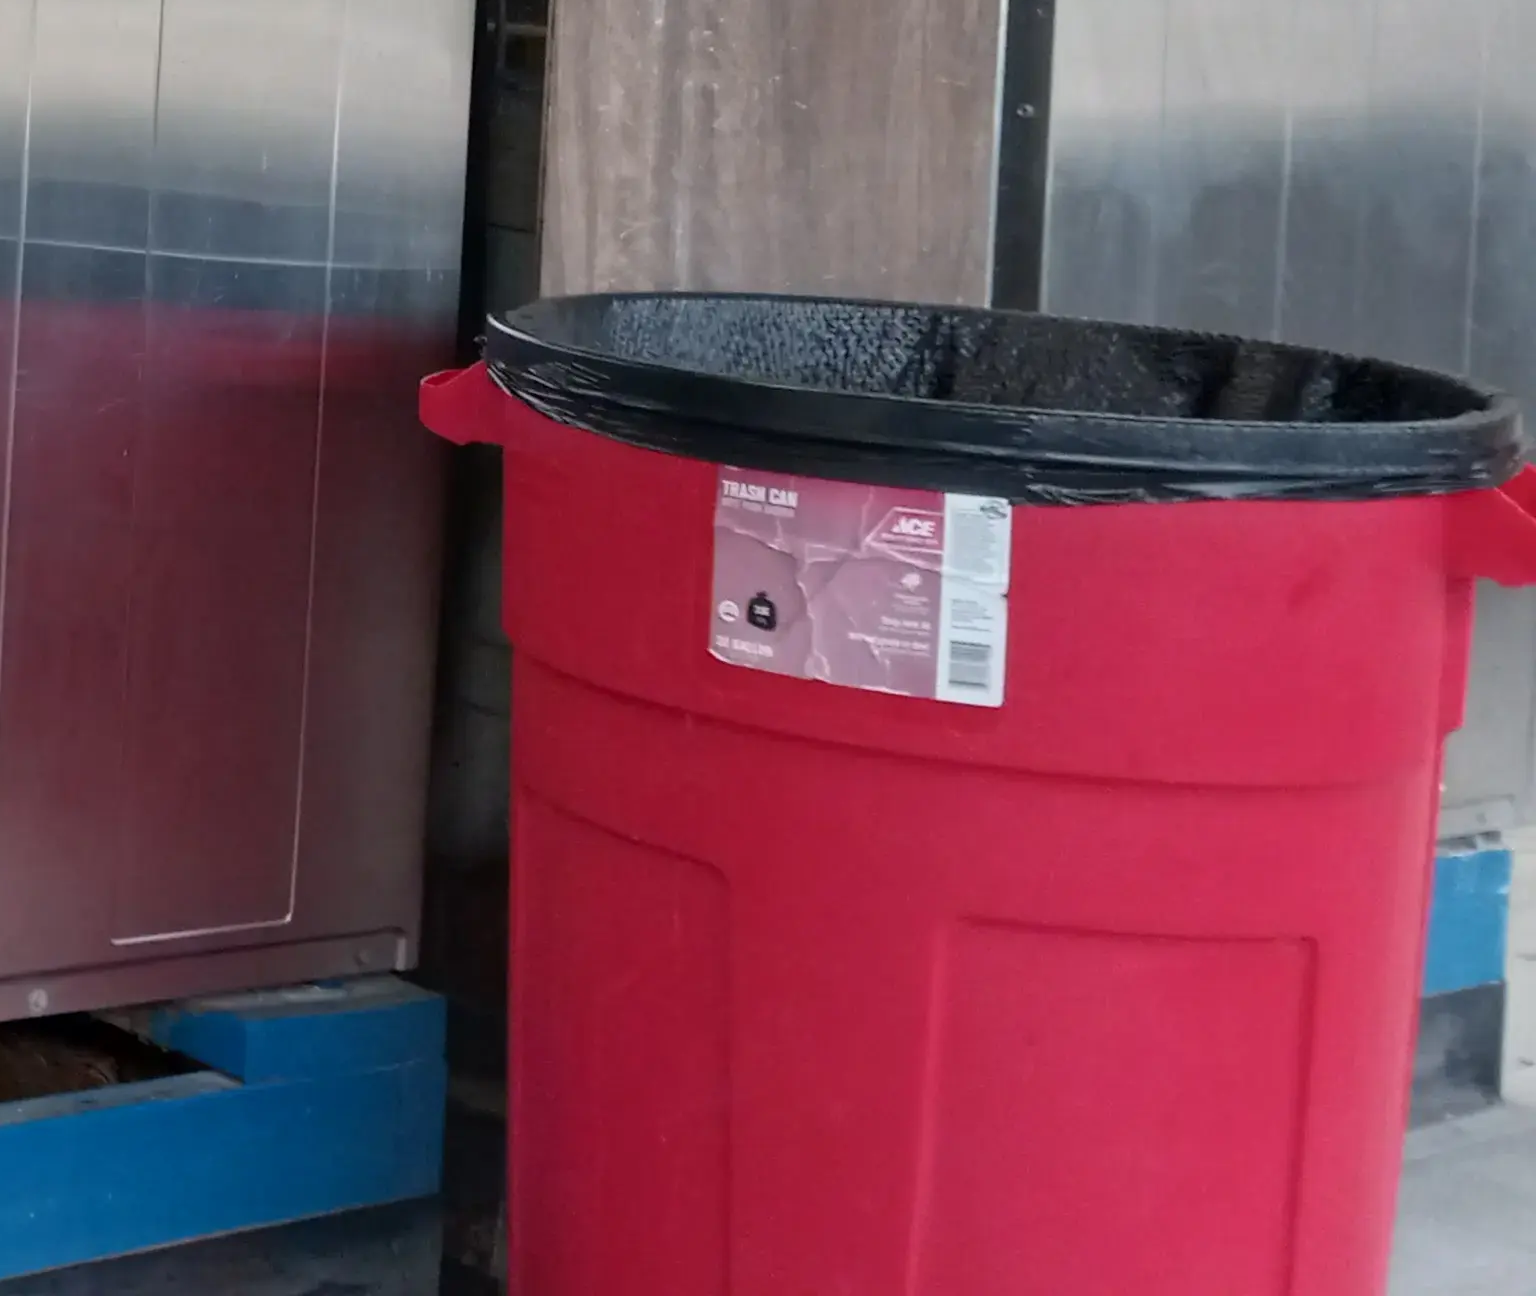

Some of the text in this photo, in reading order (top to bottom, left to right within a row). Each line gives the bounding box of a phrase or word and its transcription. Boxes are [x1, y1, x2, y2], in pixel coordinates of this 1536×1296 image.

[722, 480, 766, 502] TRASH
[769, 487, 798, 509] CAN
[891, 516, 936, 537] ACE
